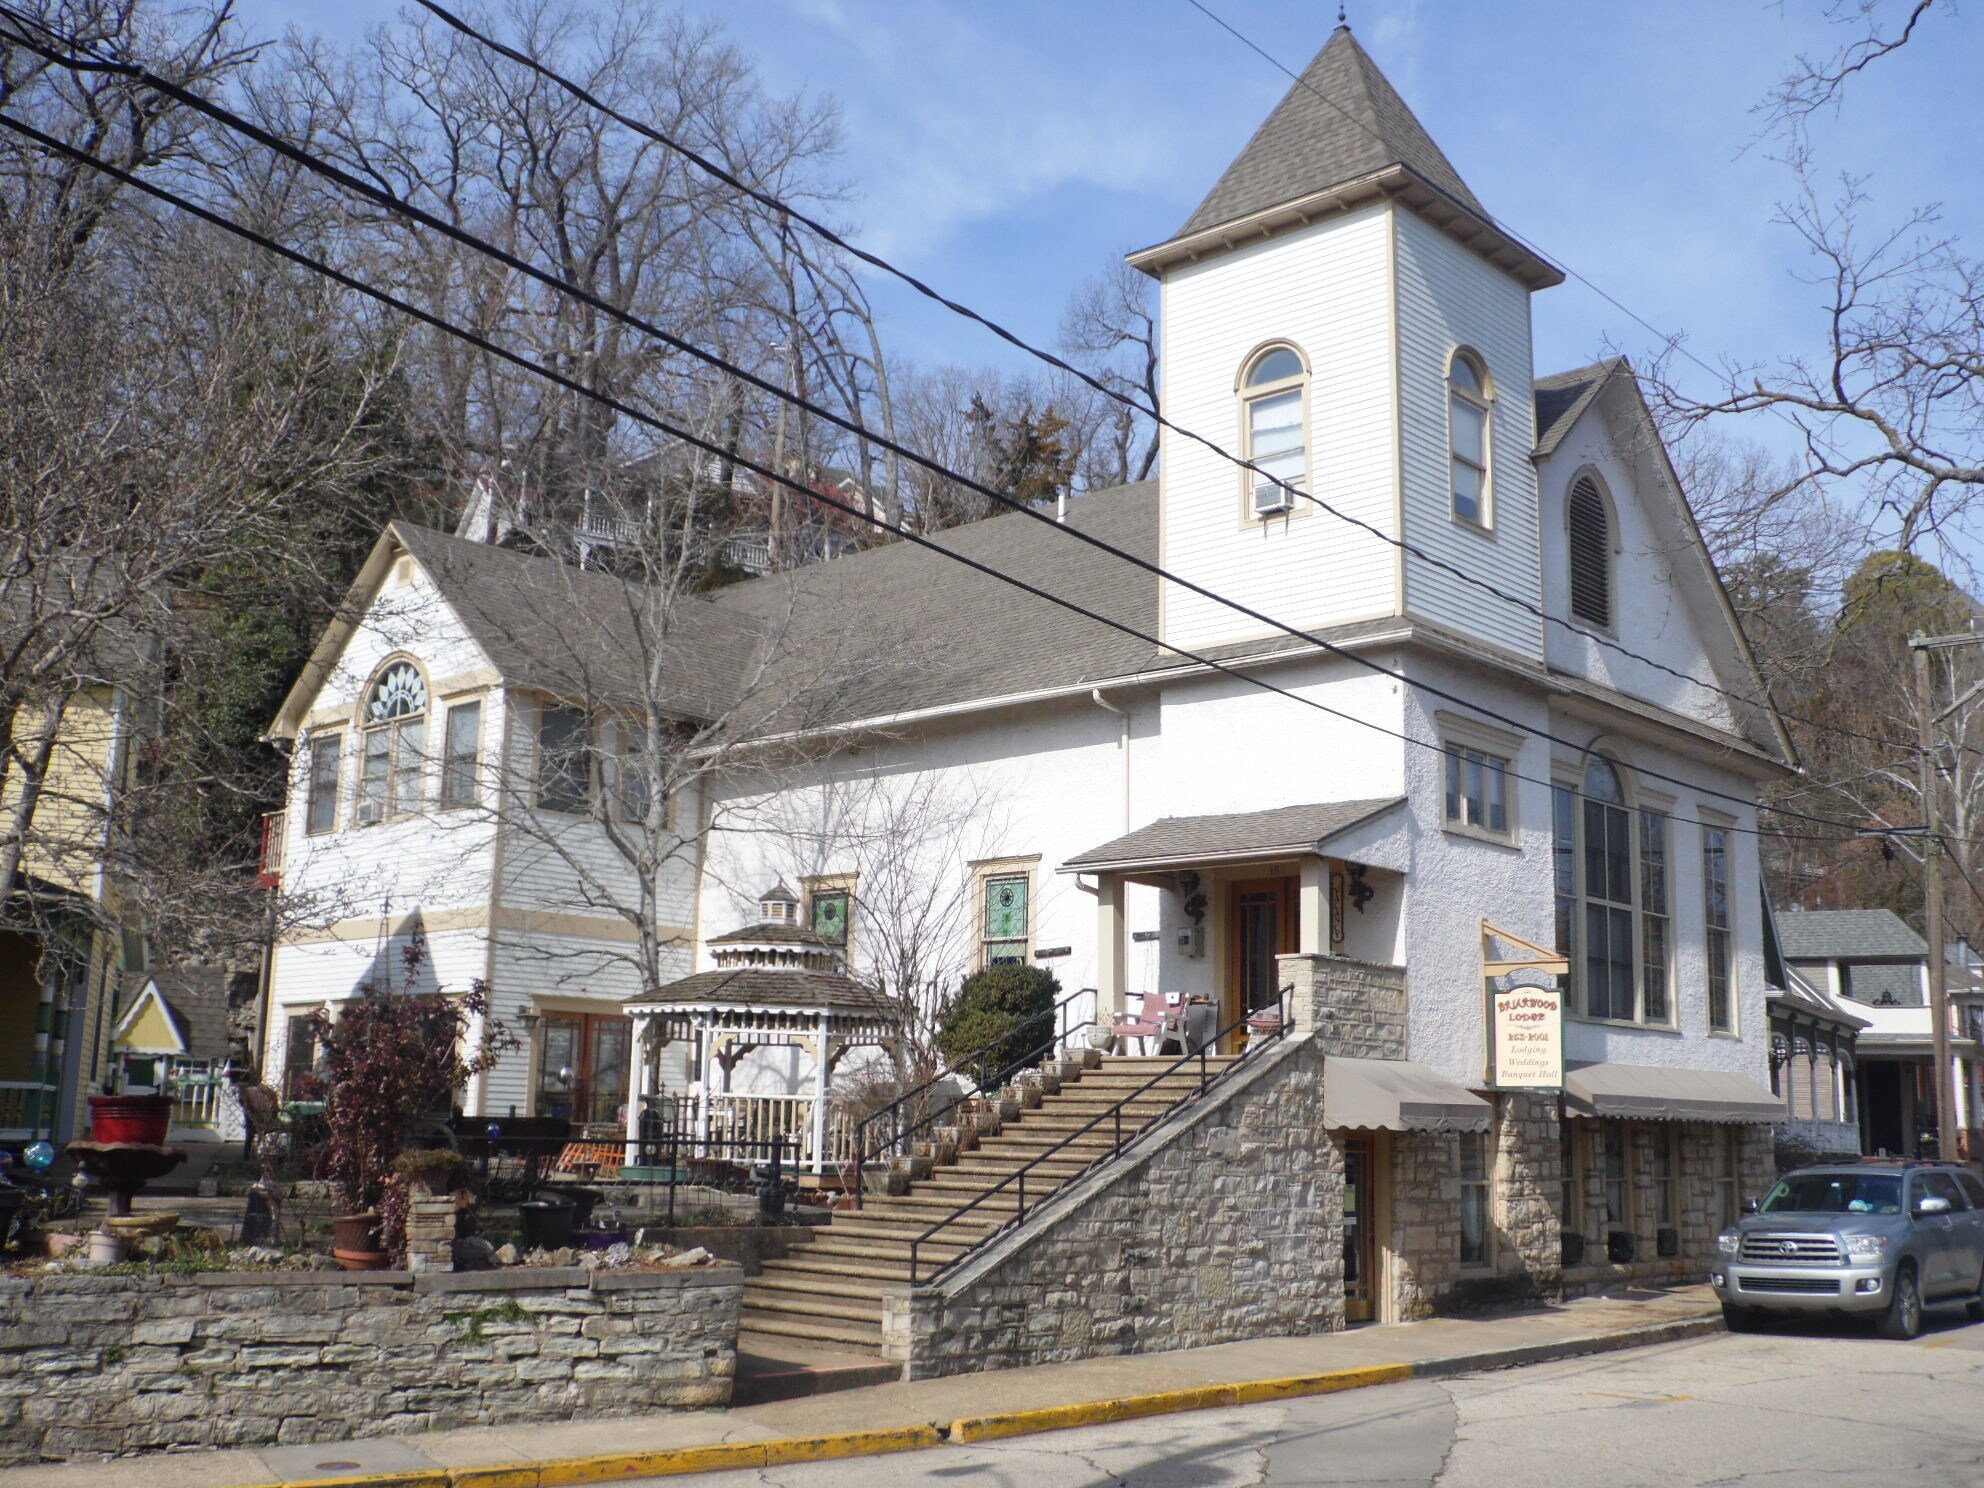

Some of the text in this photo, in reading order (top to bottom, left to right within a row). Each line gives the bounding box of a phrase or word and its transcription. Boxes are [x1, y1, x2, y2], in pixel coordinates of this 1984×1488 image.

[1497, 997, 1557, 1013] BRIARWOOD
[1509, 1012, 1545, 1021] LODGE
[1511, 1045, 1546, 1055] Lodging
[1509, 1058, 1549, 1068] Weddings
[1501, 1070, 1558, 1080] Banquet Hall
